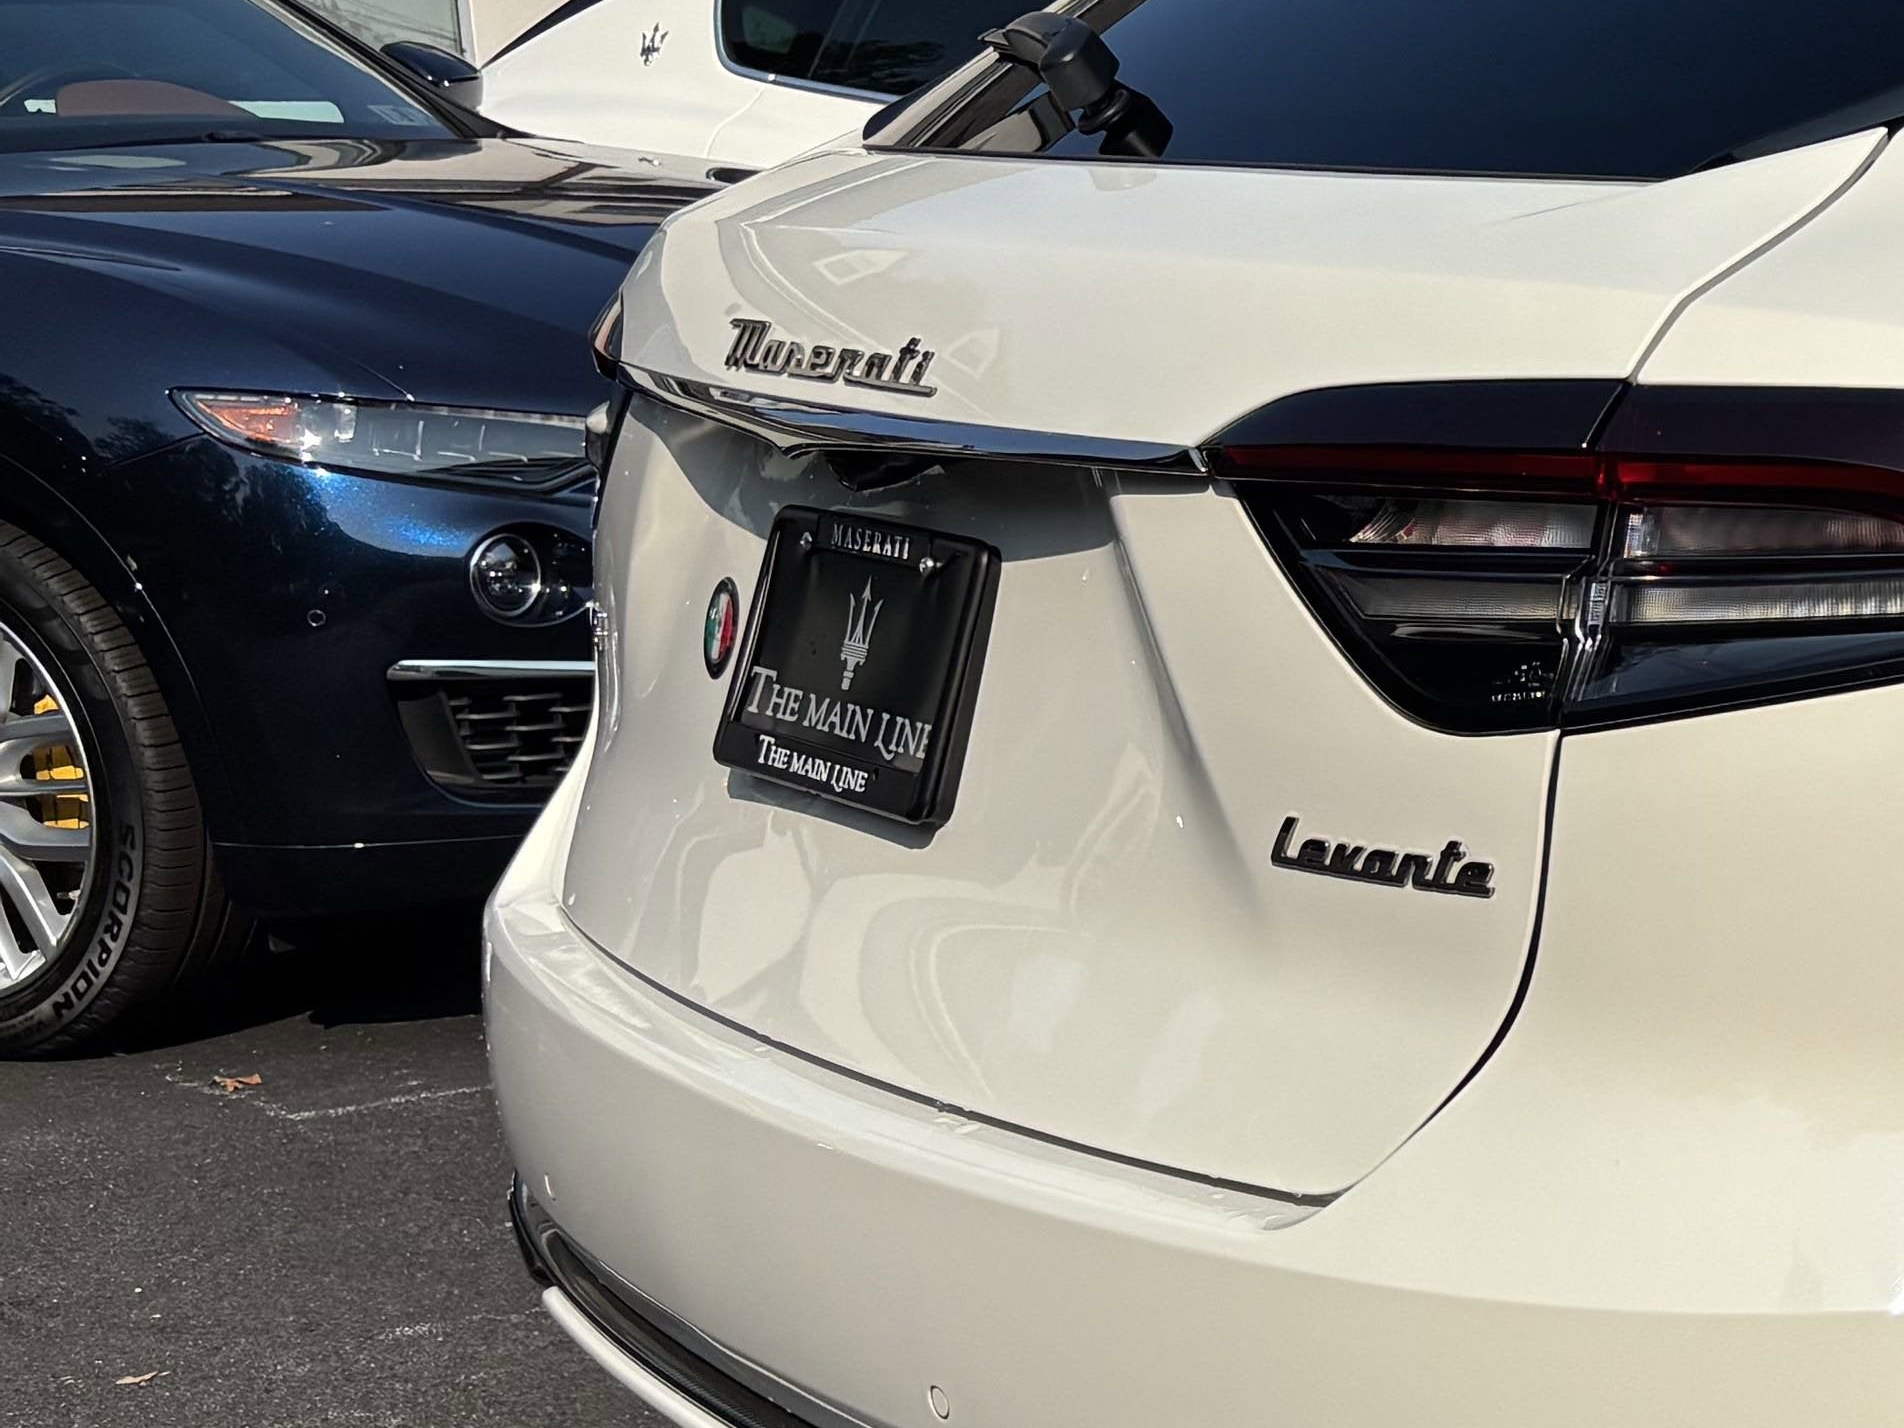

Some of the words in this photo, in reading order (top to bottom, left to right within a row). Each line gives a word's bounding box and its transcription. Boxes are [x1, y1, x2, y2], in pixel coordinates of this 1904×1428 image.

[724, 318, 938, 398] Maserati
[831, 523, 910, 560] MASERATI
[747, 666, 803, 722] THE
[803, 693, 873, 743] MAIN
[758, 735, 791, 770] THE
[790, 751, 830, 783] MAIN
[831, 762, 868, 792] LINE
[1270, 816, 1496, 899] Levante
[52, 824, 137, 1019] SCORPION
